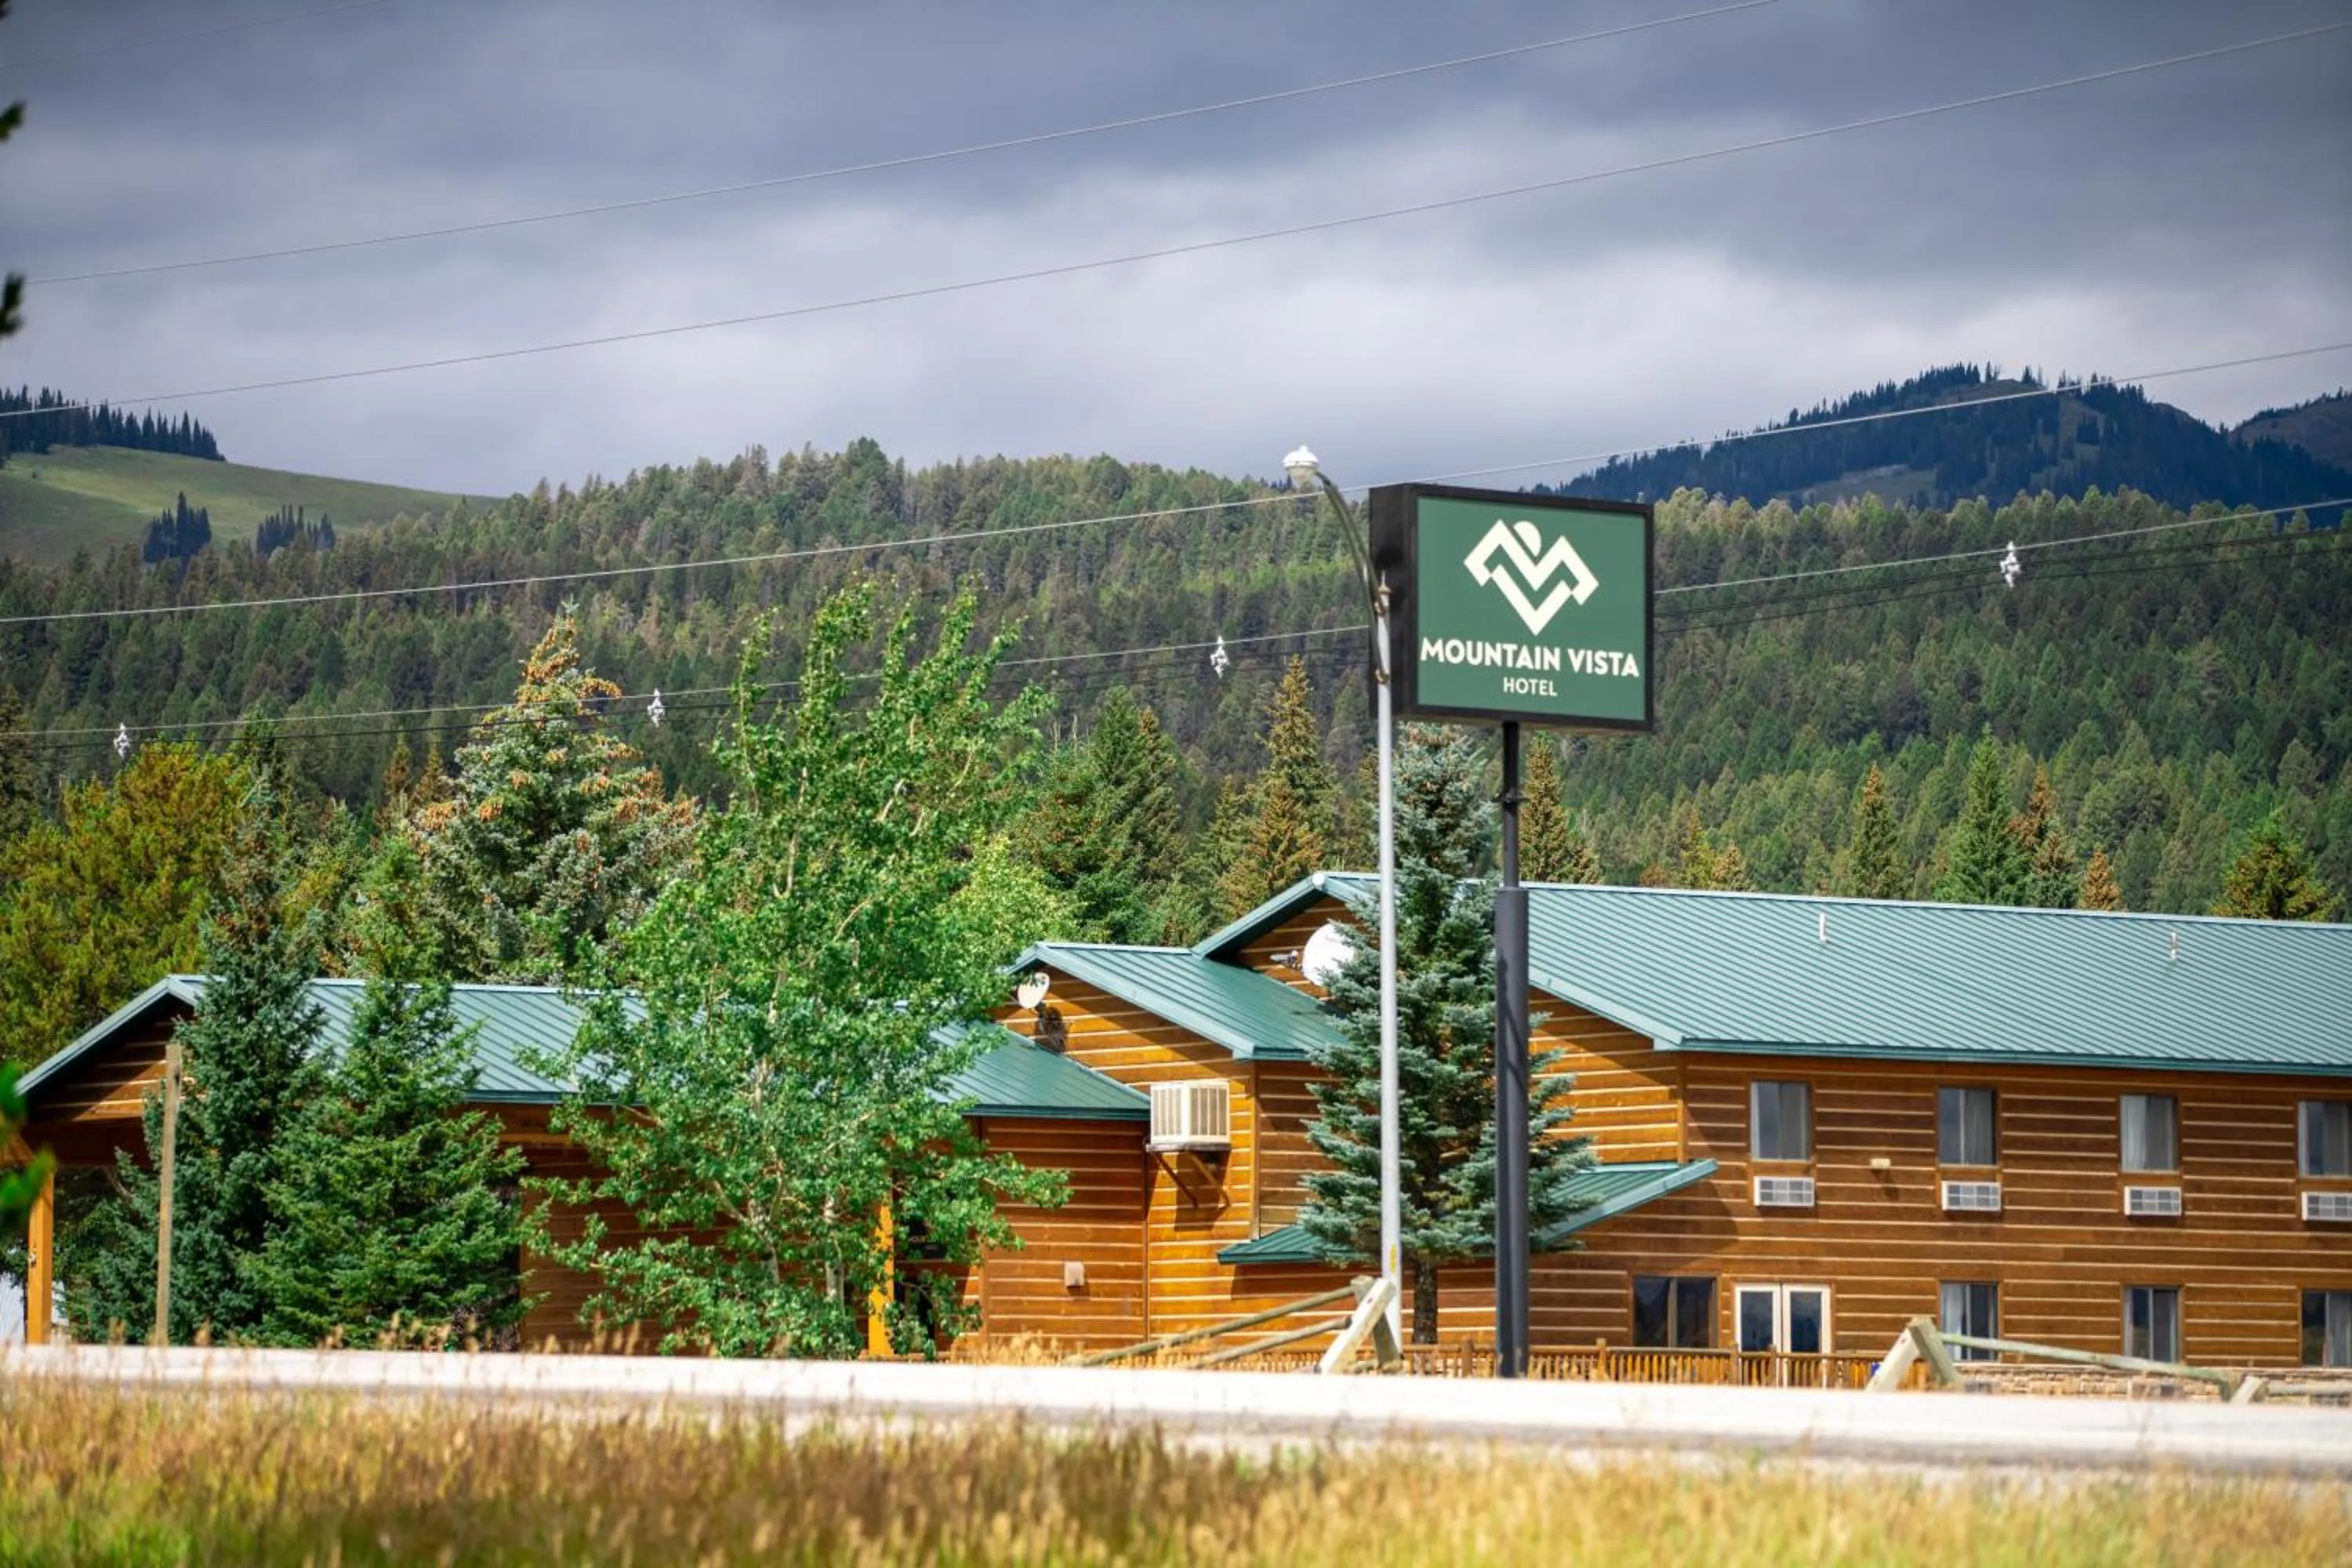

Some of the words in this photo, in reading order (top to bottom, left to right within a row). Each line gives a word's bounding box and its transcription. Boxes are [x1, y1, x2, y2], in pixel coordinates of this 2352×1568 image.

[1420, 637, 1561, 672] MOUNTAIN
[1567, 648, 1640, 677] VISTA
[1503, 677, 1558, 697] HOTEL
